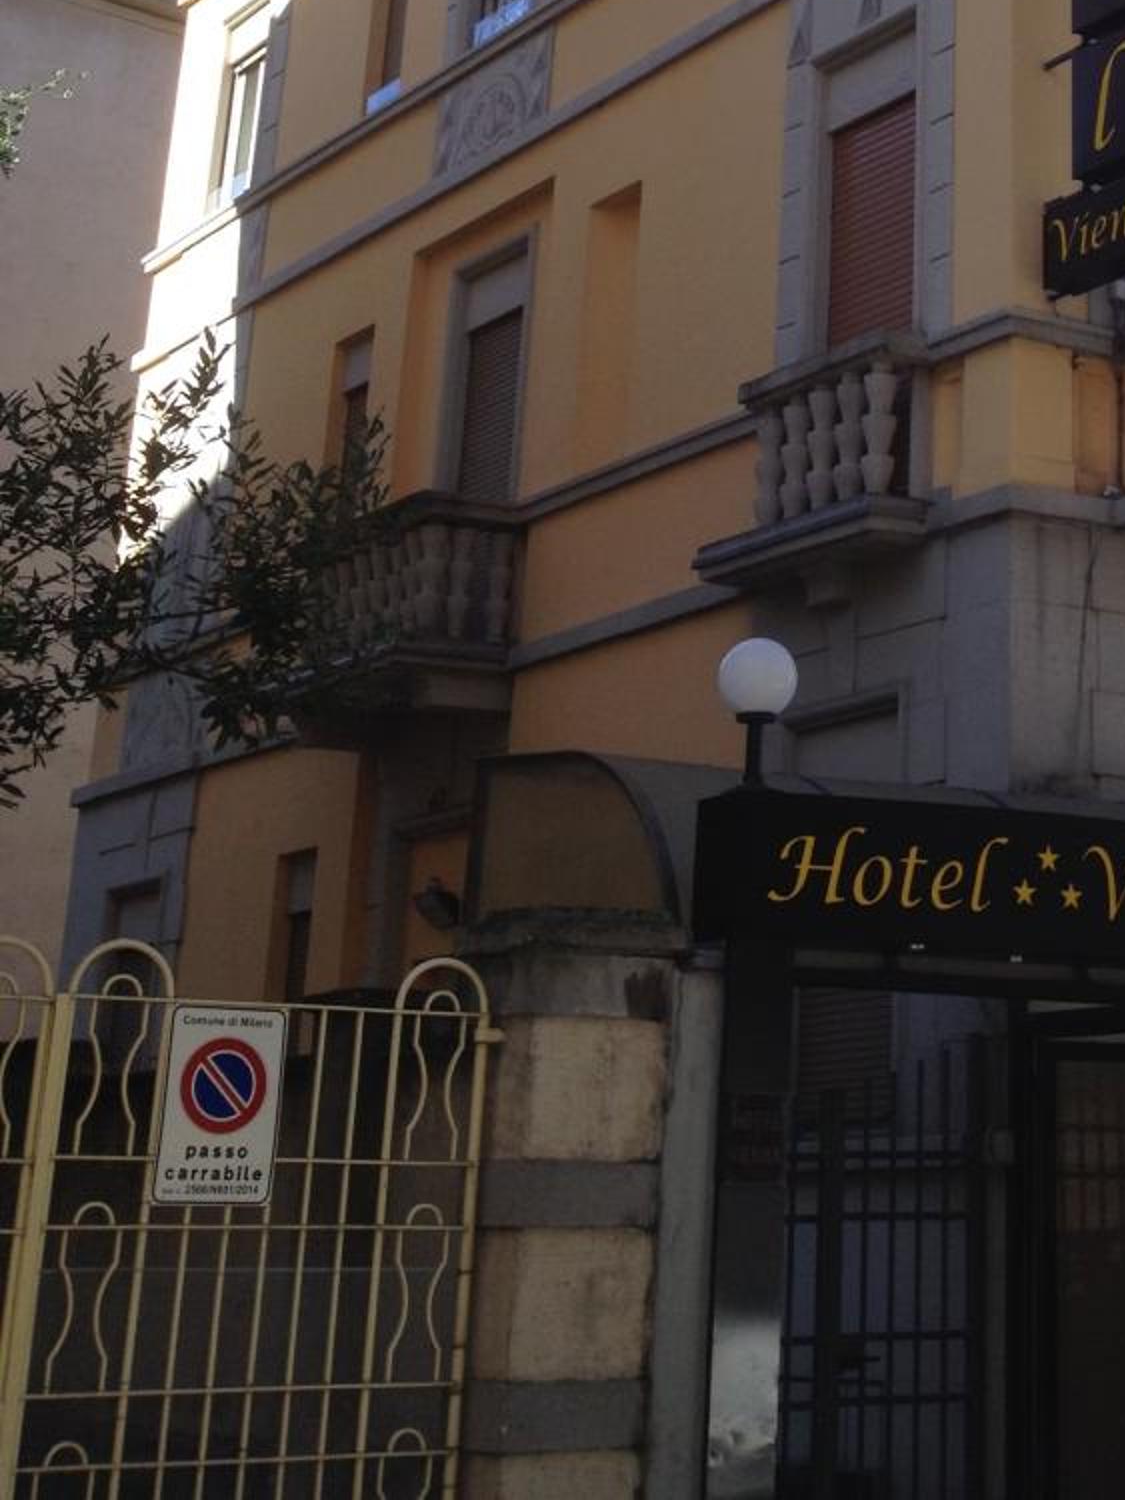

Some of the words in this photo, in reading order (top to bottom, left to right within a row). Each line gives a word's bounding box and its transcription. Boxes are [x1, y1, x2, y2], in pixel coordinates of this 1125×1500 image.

[766, 826, 1009, 914] Hotel
[185, 1145, 249, 1161] passo
[164, 1164, 263, 1182] carrabile
